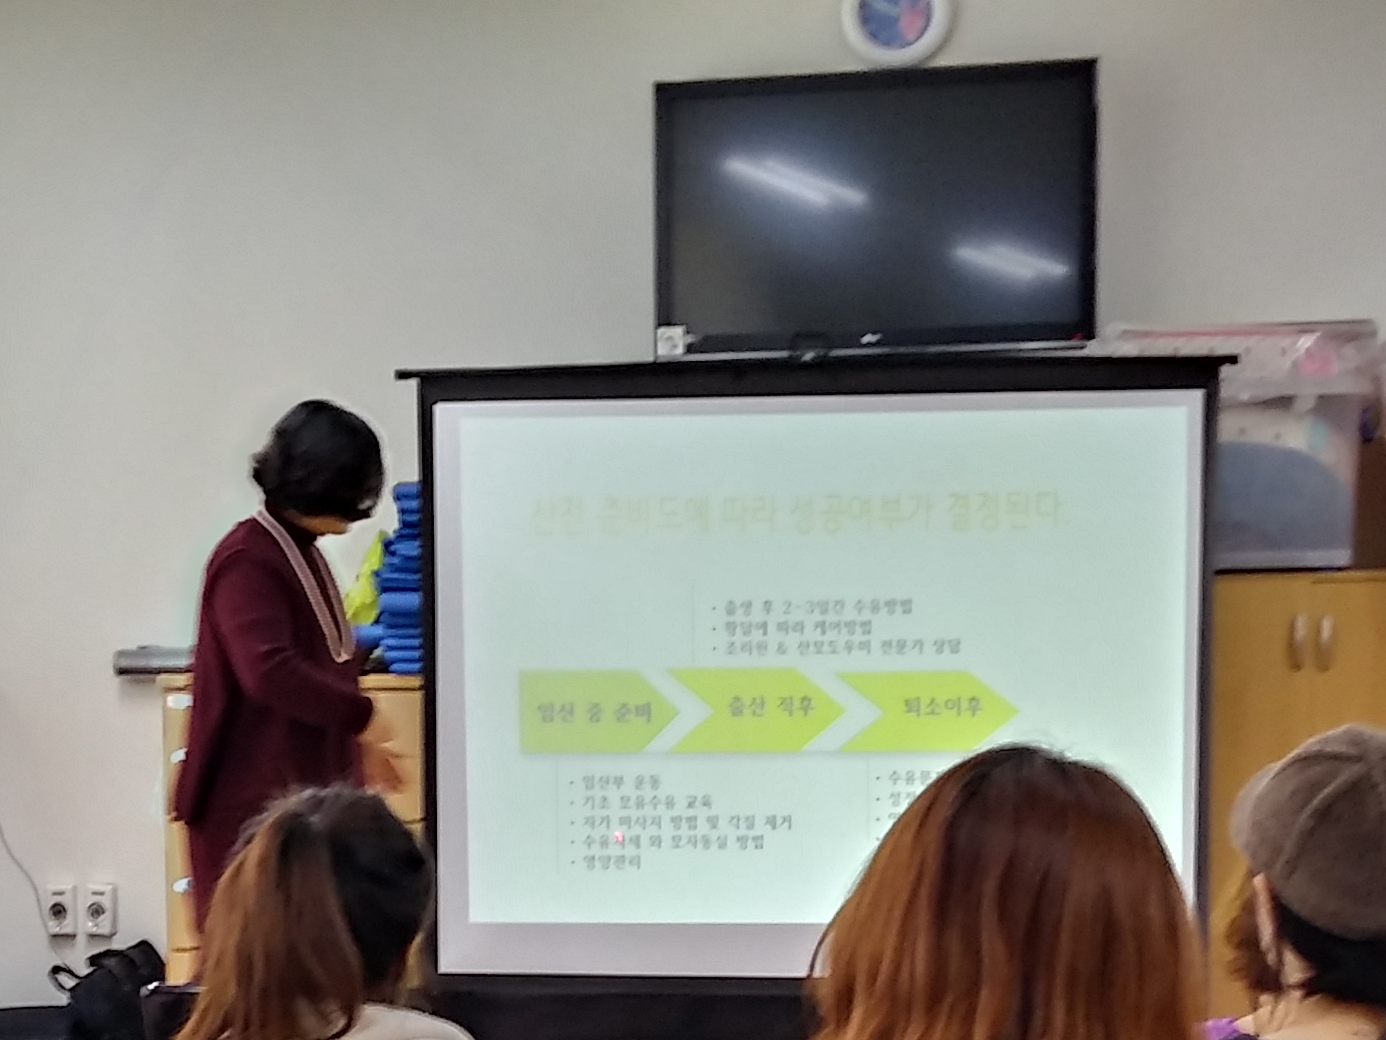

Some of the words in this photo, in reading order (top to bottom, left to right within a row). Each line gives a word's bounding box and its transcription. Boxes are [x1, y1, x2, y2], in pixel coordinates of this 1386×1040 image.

[720, 494, 776, 535] 따라
[789, 492, 932, 535] 성공여부가
[946, 490, 1066, 533] 결정된다
[853, 598, 913, 616] 수유방법
[614, 702, 652, 724] 준비
[728, 695, 766, 717] 출산
[777, 695, 816, 717] 직후
[903, 694, 984, 718] 퇴소이후
[634, 774, 661, 790] 운동
[583, 795, 610, 810] 기초
[619, 794, 675, 810] 모유수유
[685, 794, 713, 810] 교육
[583, 815, 611, 830] 자가
[670, 814, 698, 831] 방법
[764, 814, 792, 831] 제거
[736, 834, 764, 850] 방법
[583, 854, 641, 870] 영양관리
